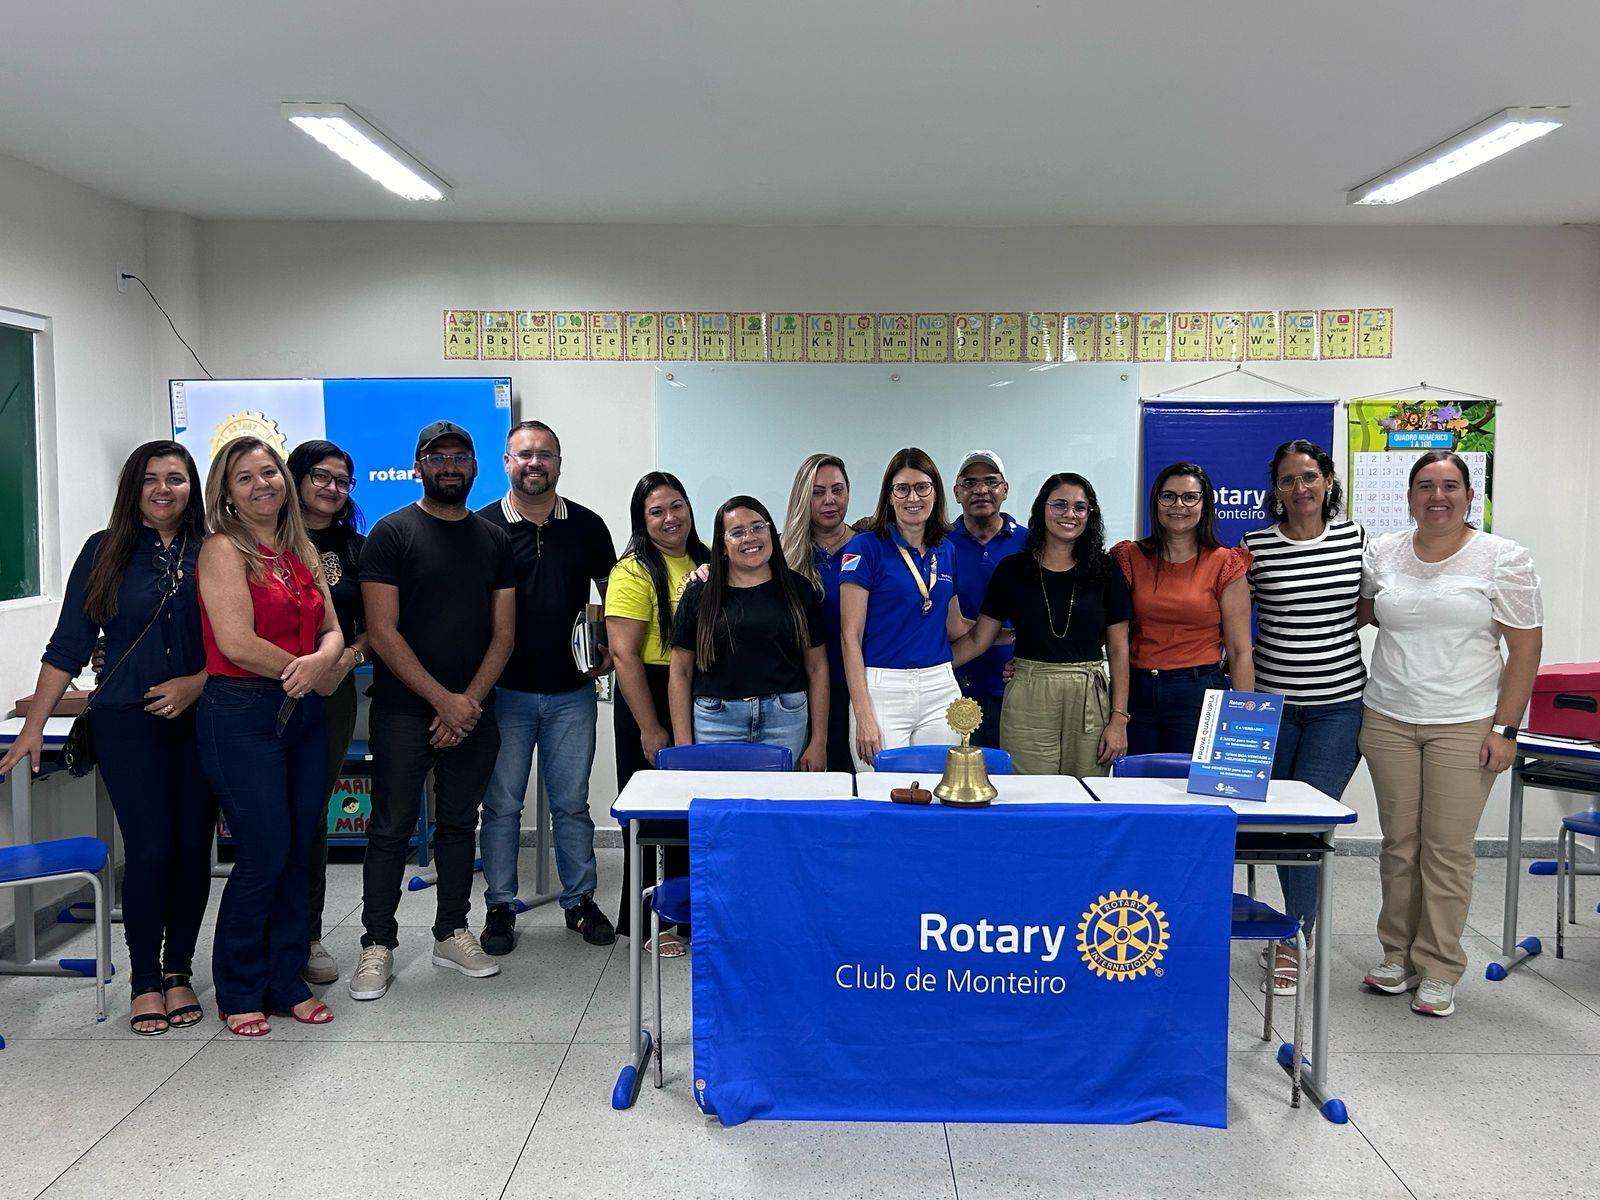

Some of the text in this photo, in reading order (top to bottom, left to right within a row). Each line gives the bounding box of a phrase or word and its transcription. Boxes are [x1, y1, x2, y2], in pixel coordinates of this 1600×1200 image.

[450, 334, 458, 344] A
[487, 335, 494, 344] B
[523, 335, 530, 344] C
[559, 336, 567, 344] D
[595, 336, 602, 344] E
[632, 336, 651, 345] F f
[667, 336, 687, 345] G g
[704, 337, 723, 345] H h
[777, 337, 794, 347] J j
[812, 337, 819, 346] K
[849, 338, 854, 346] L
[883, 337, 893, 346] M
[921, 337, 929, 346] N
[958, 337, 966, 346] O
[995, 337, 1001, 345] P
[1031, 336, 1038, 346] Q
[1068, 337, 1074, 345] R
[1105, 337, 1110, 345] S
[1142, 337, 1148, 345] T
[1179, 337, 1186, 345] U
[1216, 336, 1223, 345] V
[1251, 336, 1261, 344] W
[1289, 335, 1296, 343] X
[1327, 334, 1333, 343] Y
[1364, 334, 1370, 342] Z
[1419, 433, 1448, 441] NUMÉRICO
[1213, 487, 1266, 509] tary
[1222, 722, 1227, 730] 1
[1198, 737, 1206, 760] PROVA
[1262, 741, 1270, 749] 2
[1214, 751, 1221, 760] 3
[1256, 770, 1265, 779] 4
[1104, 900, 1142, 911] ROTARY
[920, 913, 1066, 962] Rotary
[1091, 950, 1155, 971] INTERNATIONAL
[835, 964, 1066, 994] Club de Monteiro
